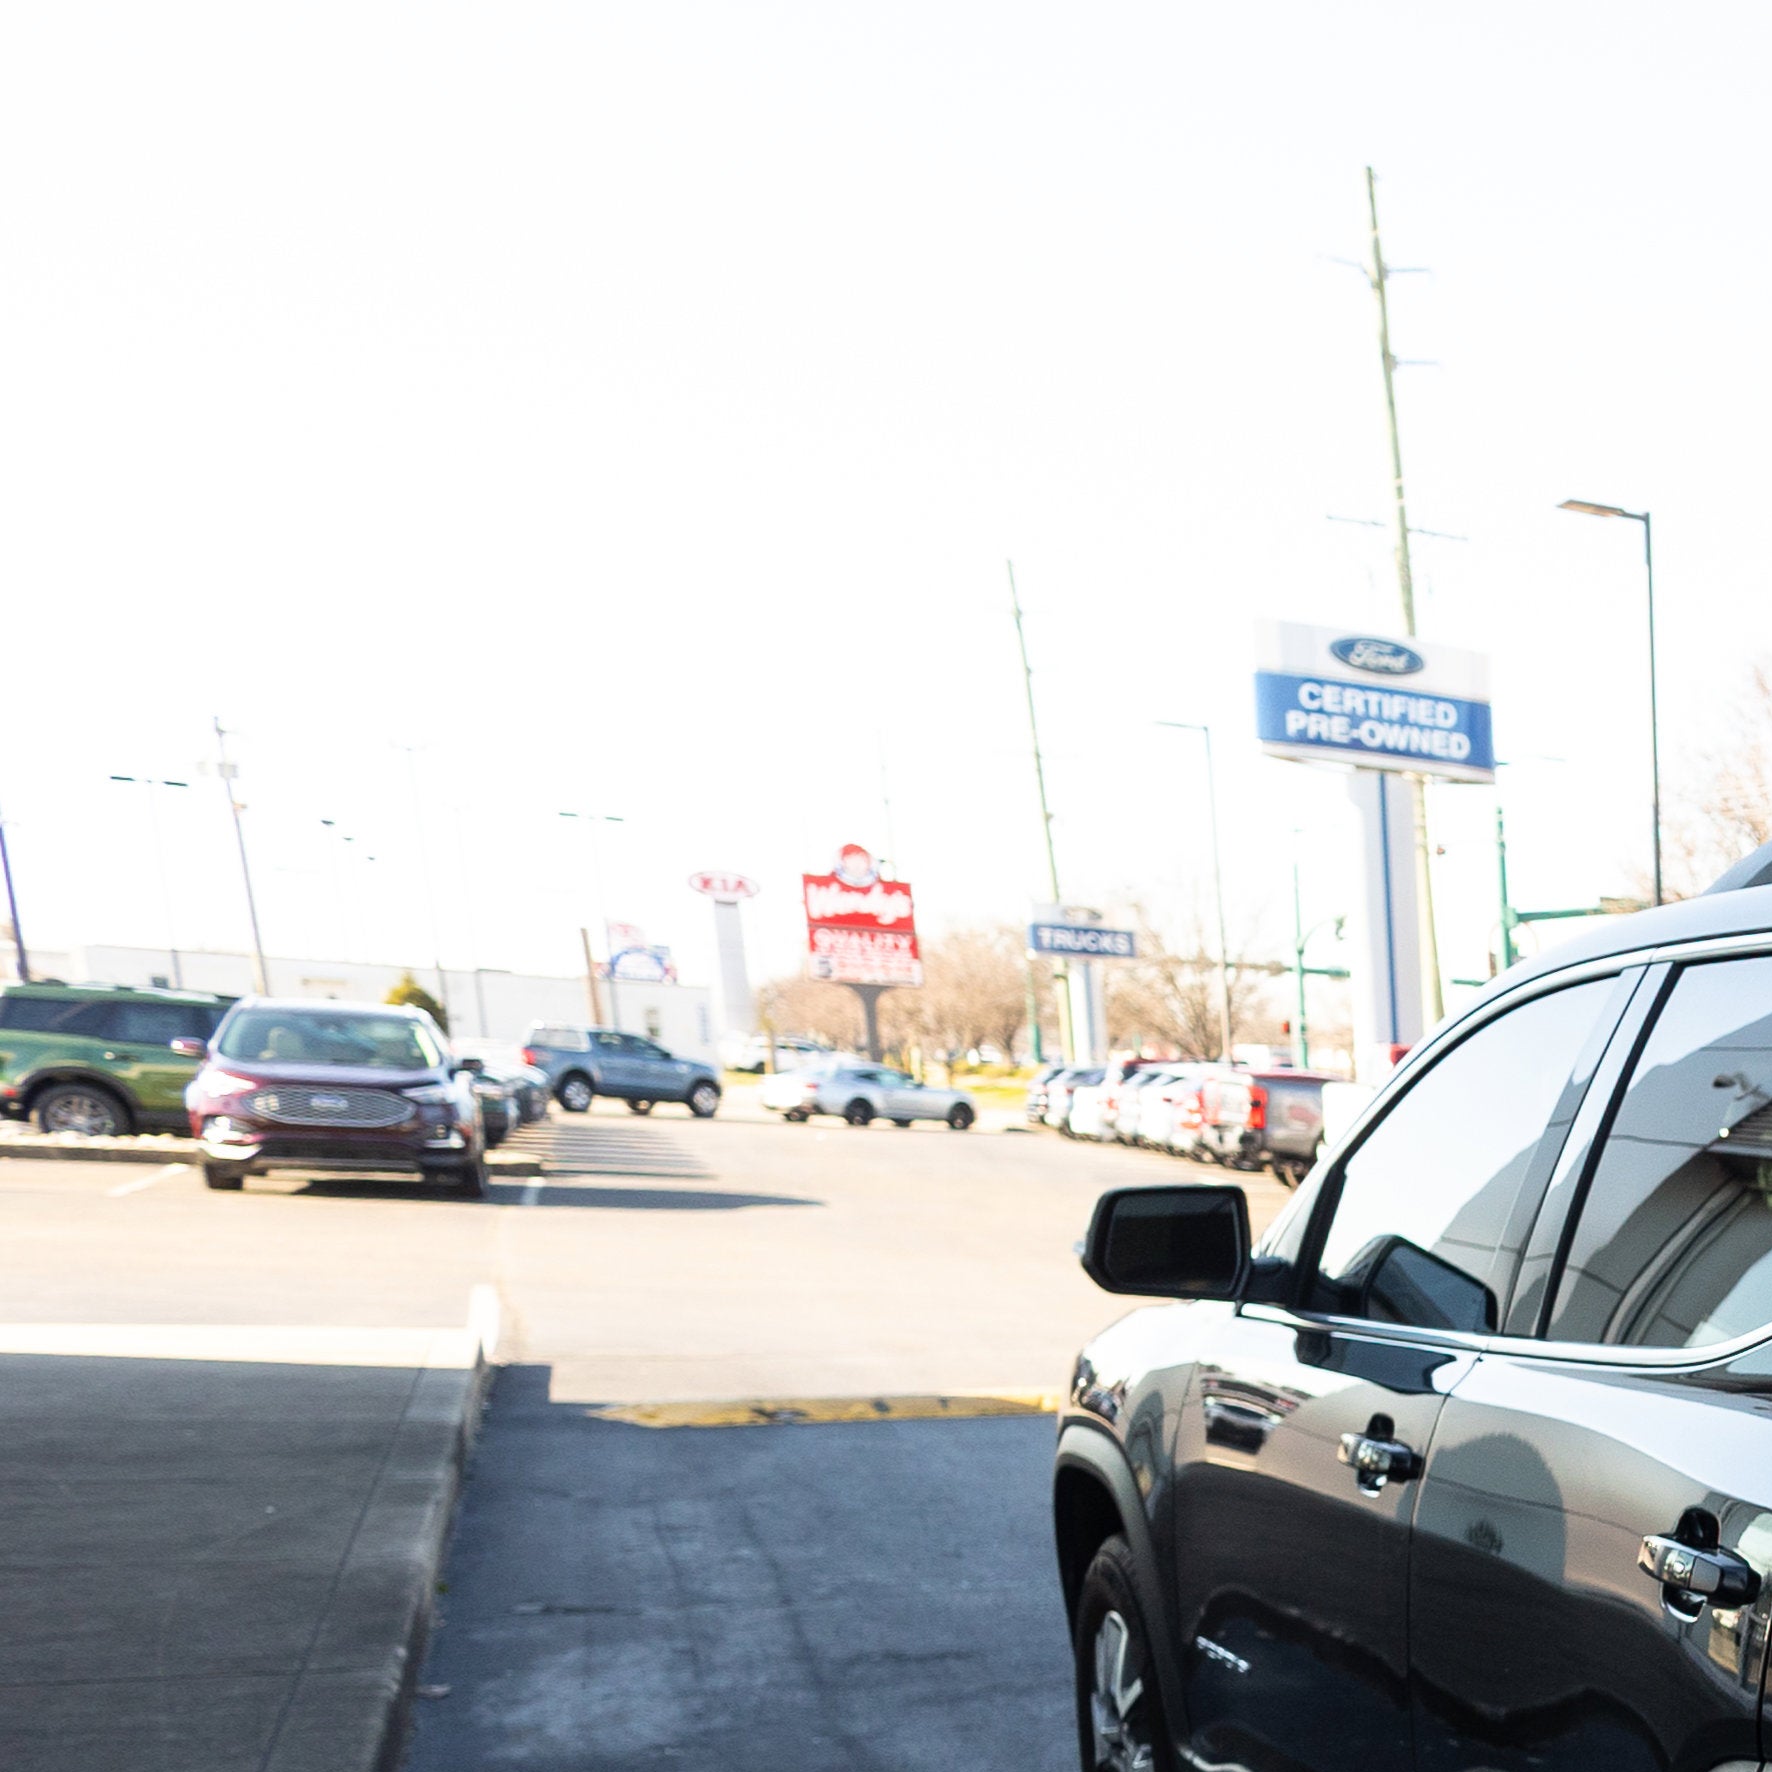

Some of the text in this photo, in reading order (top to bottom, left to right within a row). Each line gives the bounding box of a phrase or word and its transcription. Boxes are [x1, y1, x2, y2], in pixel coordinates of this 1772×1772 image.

[1298, 682, 1458, 729] CERTIFIED
[1285, 709, 1471, 760] PRE-OWNED
[699, 876, 752, 894] KIA
[1037, 926, 1131, 955] TRUCKS
